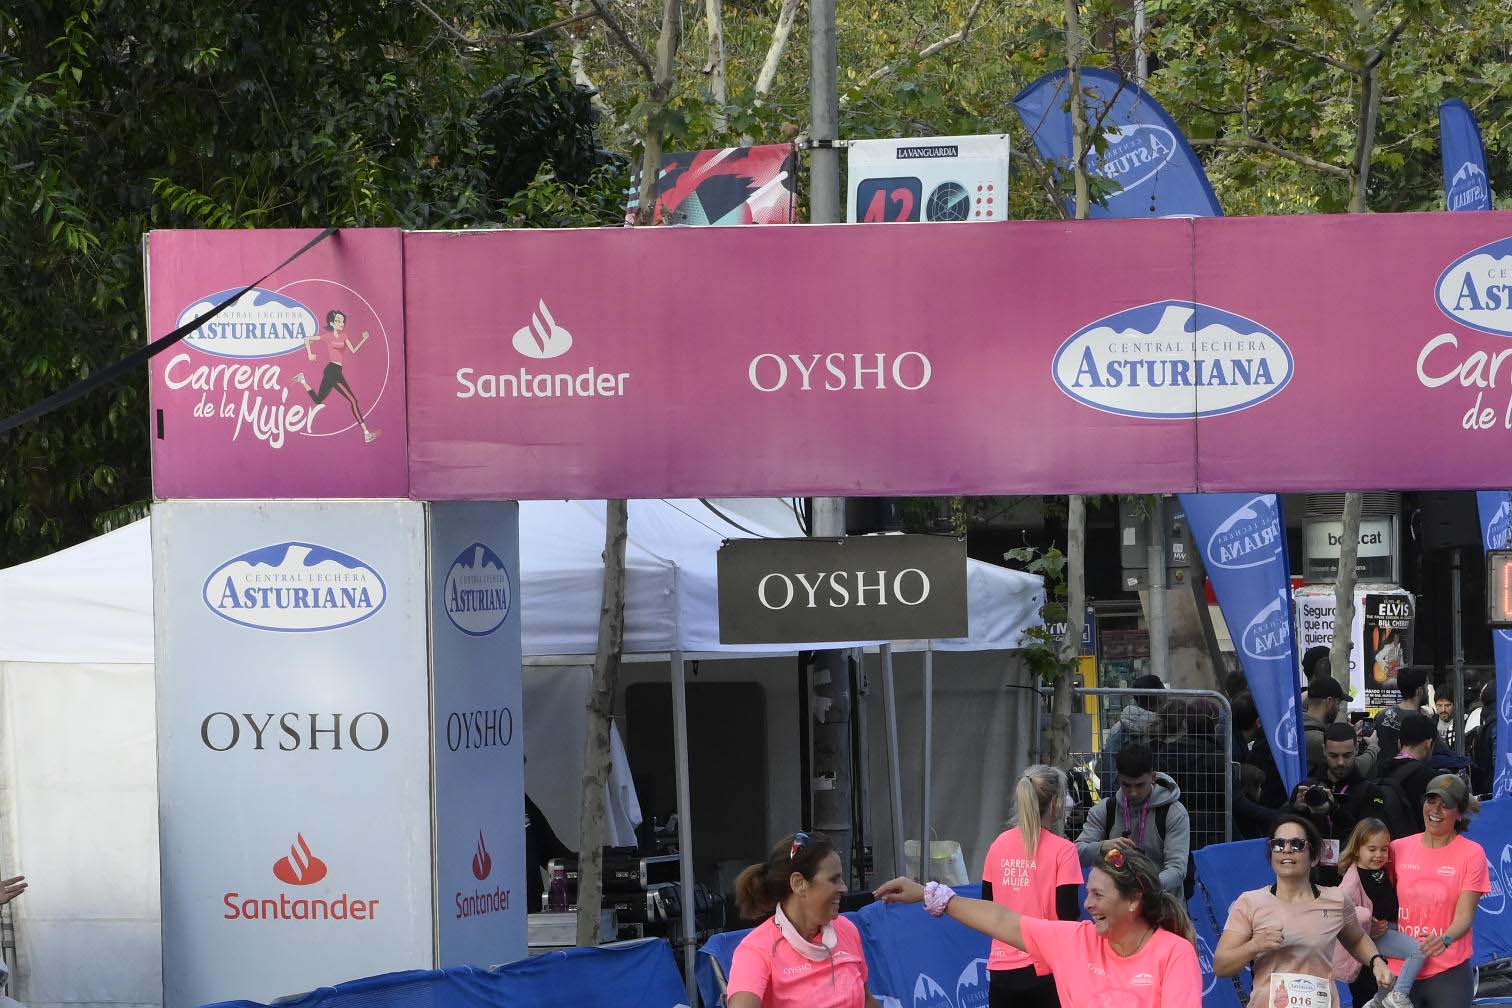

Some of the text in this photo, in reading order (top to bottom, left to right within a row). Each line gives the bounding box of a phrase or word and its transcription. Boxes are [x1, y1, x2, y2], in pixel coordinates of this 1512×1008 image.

[1107, 340, 1267, 354] CENTRAL LECHERA
[164, 353, 281, 391] Carrera
[747, 351, 933, 393] OYSHO
[1071, 345, 1276, 389] ASTURIANA
[455, 367, 631, 400] Santander
[193, 387, 327, 449] de la Mujer
[1462, 391, 1496, 430] de
[218, 575, 374, 609] ASTURIANA
[244, 573, 367, 582] CENTRAL LECHERA
[757, 568, 931, 611] OYSHO
[449, 584, 507, 613] ASTURIANA
[1378, 603, 1409, 616] ELVIS
[1304, 620, 1321, 630] que
[200, 711, 390, 752] OYSHO
[447, 707, 513, 752] OYSHO
[1002, 877, 1030, 888] MUJER
[1004, 867, 1029, 878] DE LA
[223, 892, 380, 920] Santander
[455, 888, 510, 919] Santander
[1290, 996, 1312, 1006] 016
